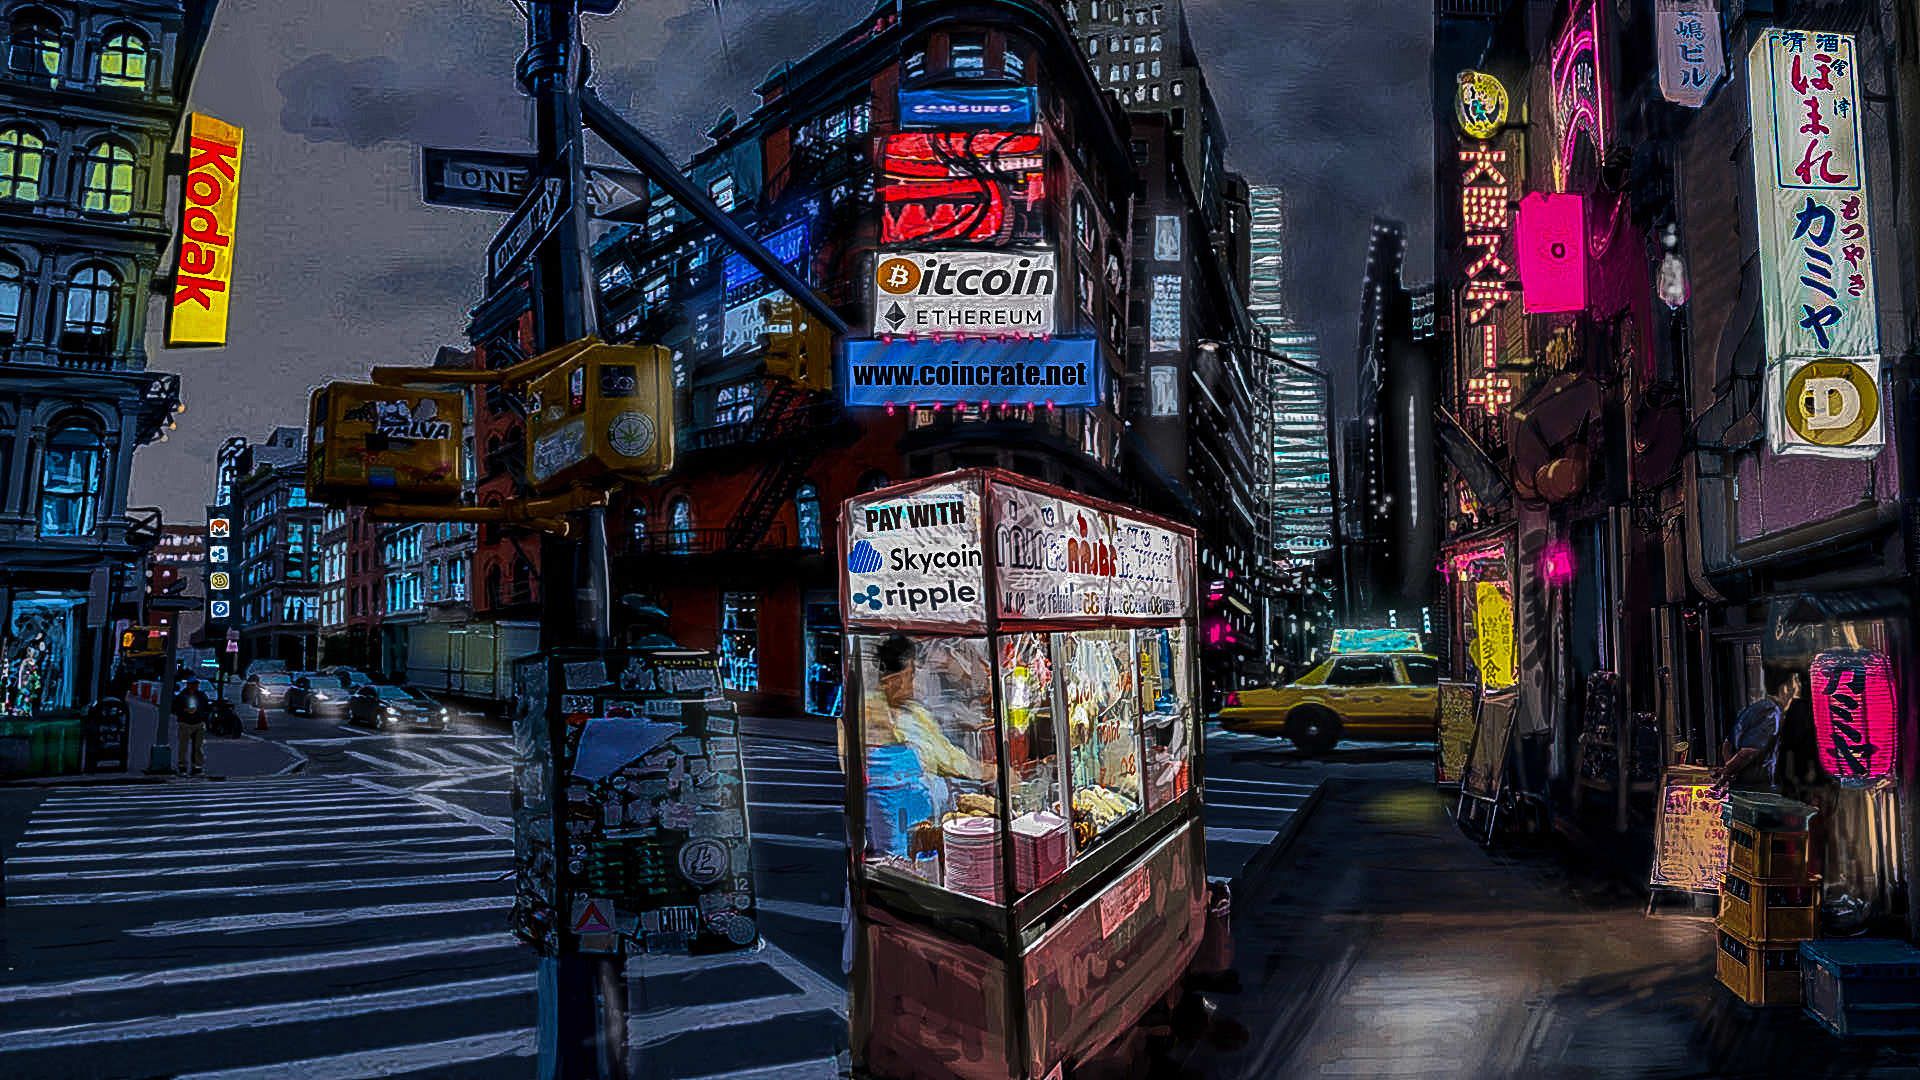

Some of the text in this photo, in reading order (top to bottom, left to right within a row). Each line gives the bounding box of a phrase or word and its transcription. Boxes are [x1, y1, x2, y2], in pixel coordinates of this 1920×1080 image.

[912, 104, 1012, 114] SAMSUNG
[1791, 54, 1848, 184] ほまれ
[461, 168, 528, 193] ONE
[174, 136, 237, 310] Kodak
[1840, 196, 1866, 297] もつやき
[882, 258, 1054, 296] Bitcoin
[1792, 197, 1843, 350] カミヤ
[916, 310, 1042, 325] ETHEREUM
[853, 361, 1088, 386] www.coincrate.net
[865, 500, 966, 532] PAY WITH
[890, 543, 982, 575] Skycoin
[884, 580, 976, 612] ripple
[1823, 664, 1878, 775] カミヤ
